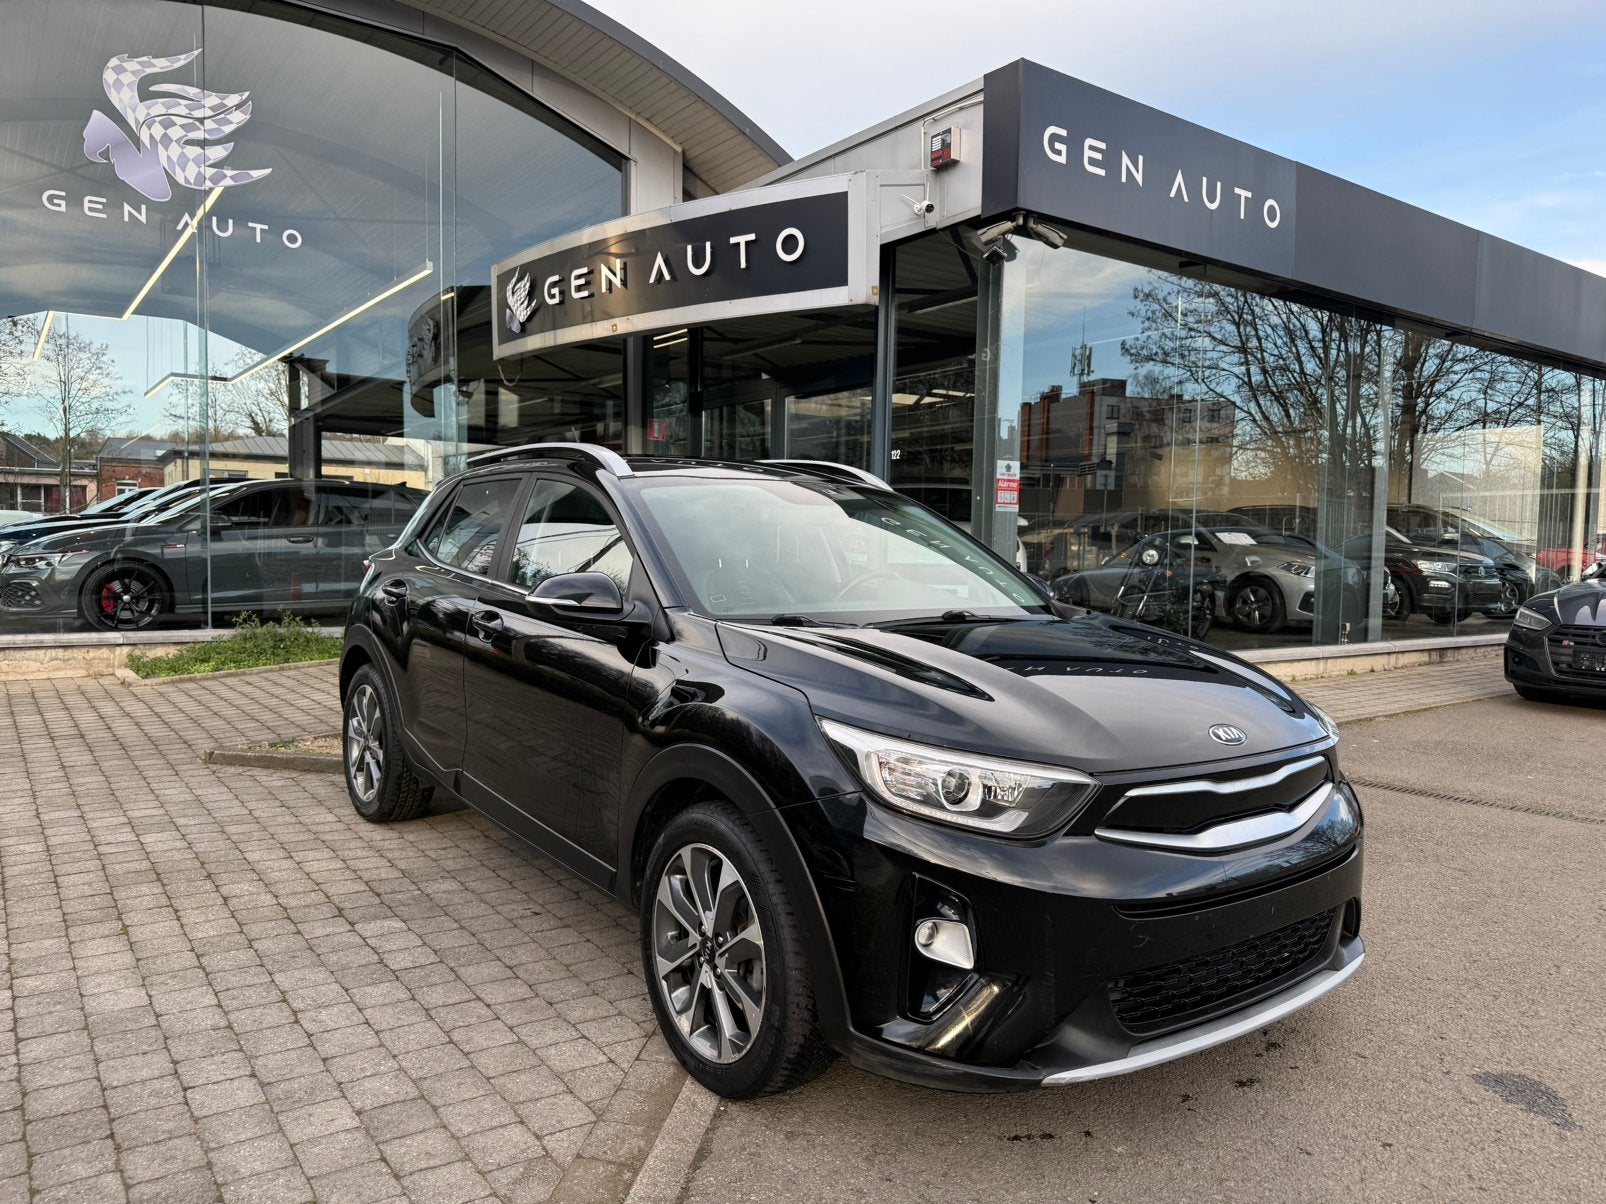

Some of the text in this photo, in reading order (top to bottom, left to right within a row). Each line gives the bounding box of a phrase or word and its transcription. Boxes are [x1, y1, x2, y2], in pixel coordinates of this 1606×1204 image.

[1042, 125, 1281, 229] GEN AUTO
[41, 189, 302, 249] GEN AUTO
[543, 226, 805, 306] GEN AUTO
[891, 449, 901, 460] 122
[998, 479, 1018, 488] Alarme
[1213, 727, 1244, 741] KIA
